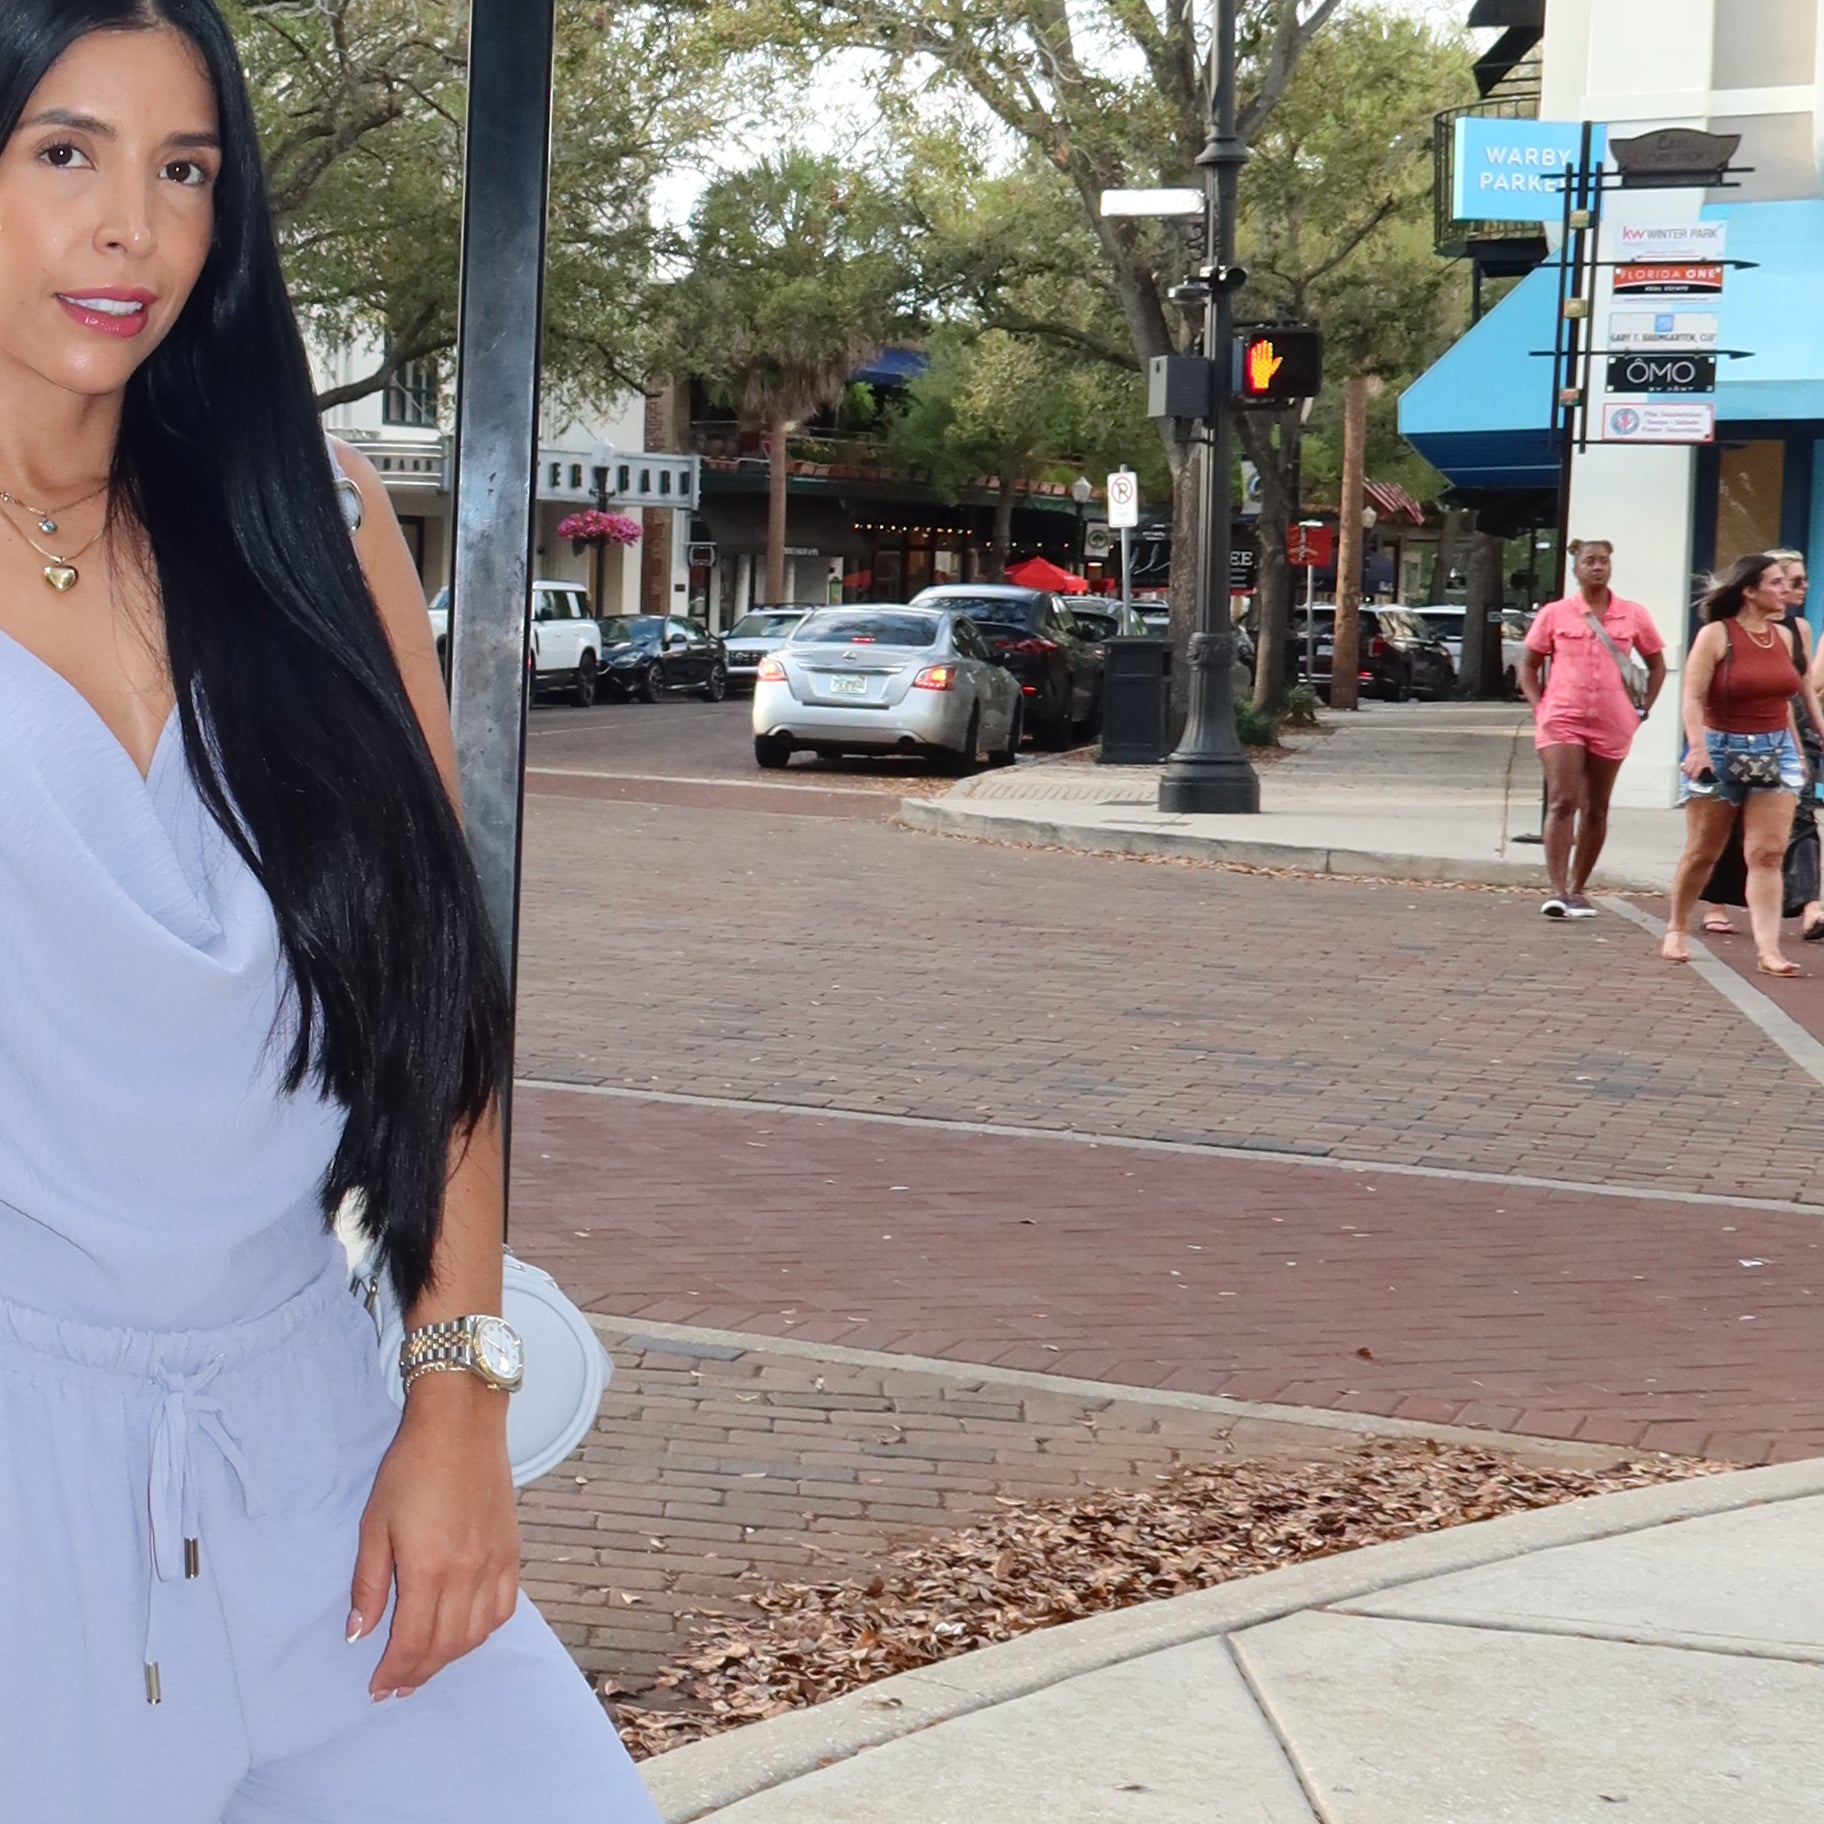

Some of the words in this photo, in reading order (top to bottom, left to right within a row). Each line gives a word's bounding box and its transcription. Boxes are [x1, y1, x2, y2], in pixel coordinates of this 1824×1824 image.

[1486, 145, 1572, 167] WARBY
[1479, 171, 1567, 194] PARKE
[1646, 227, 1687, 241] WINTER
[1689, 227, 1718, 240] PARK
[1620, 268, 1681, 281] FLORIDA
[1685, 268, 1716, 280] ONE
